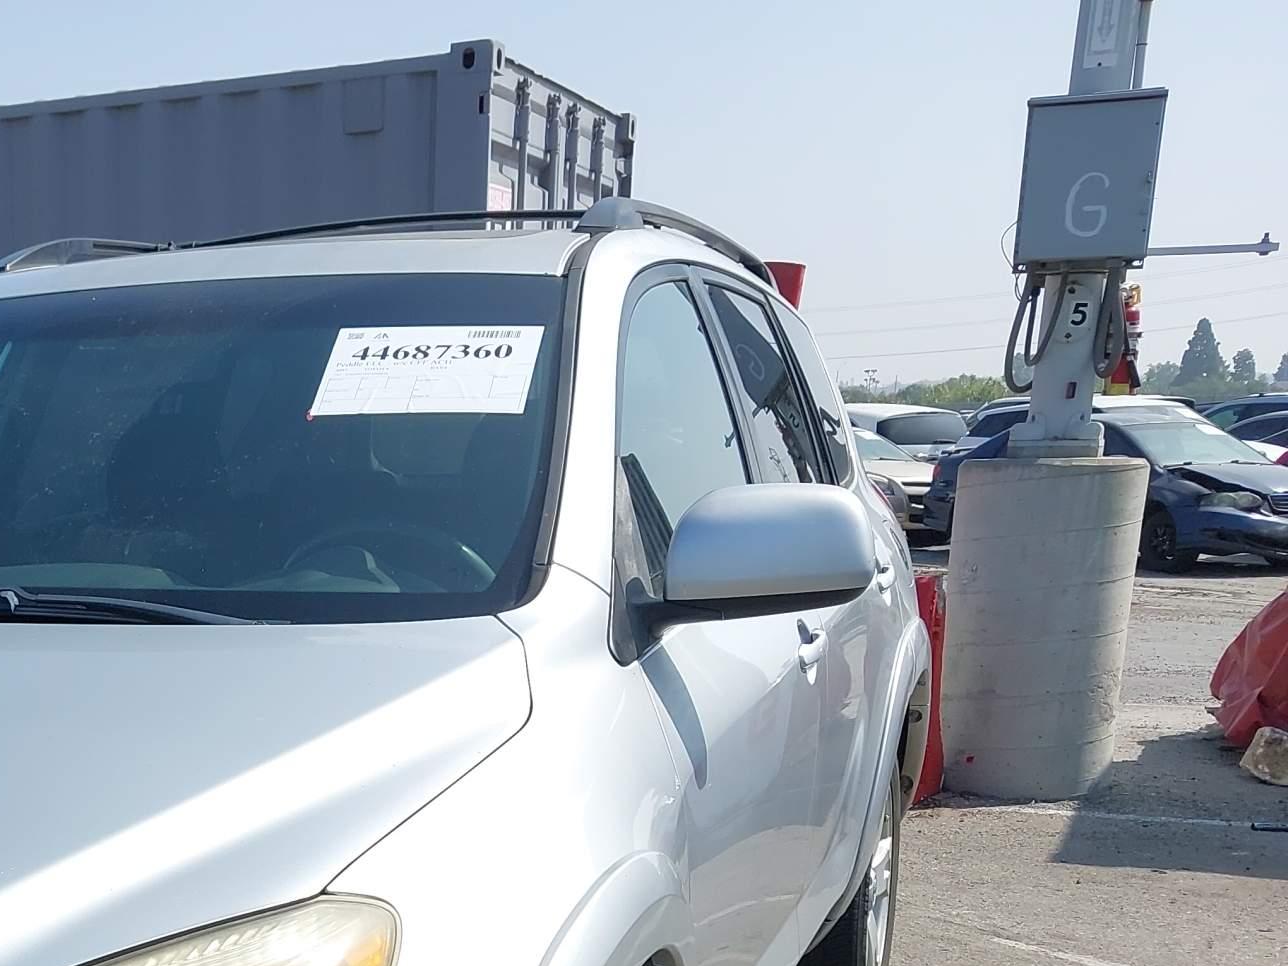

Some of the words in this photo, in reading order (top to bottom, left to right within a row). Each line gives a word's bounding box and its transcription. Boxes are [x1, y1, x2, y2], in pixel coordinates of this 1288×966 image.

[1064, 172, 1111, 238] G
[1070, 302, 1089, 326] 5
[352, 343, 514, 361] 44687360
